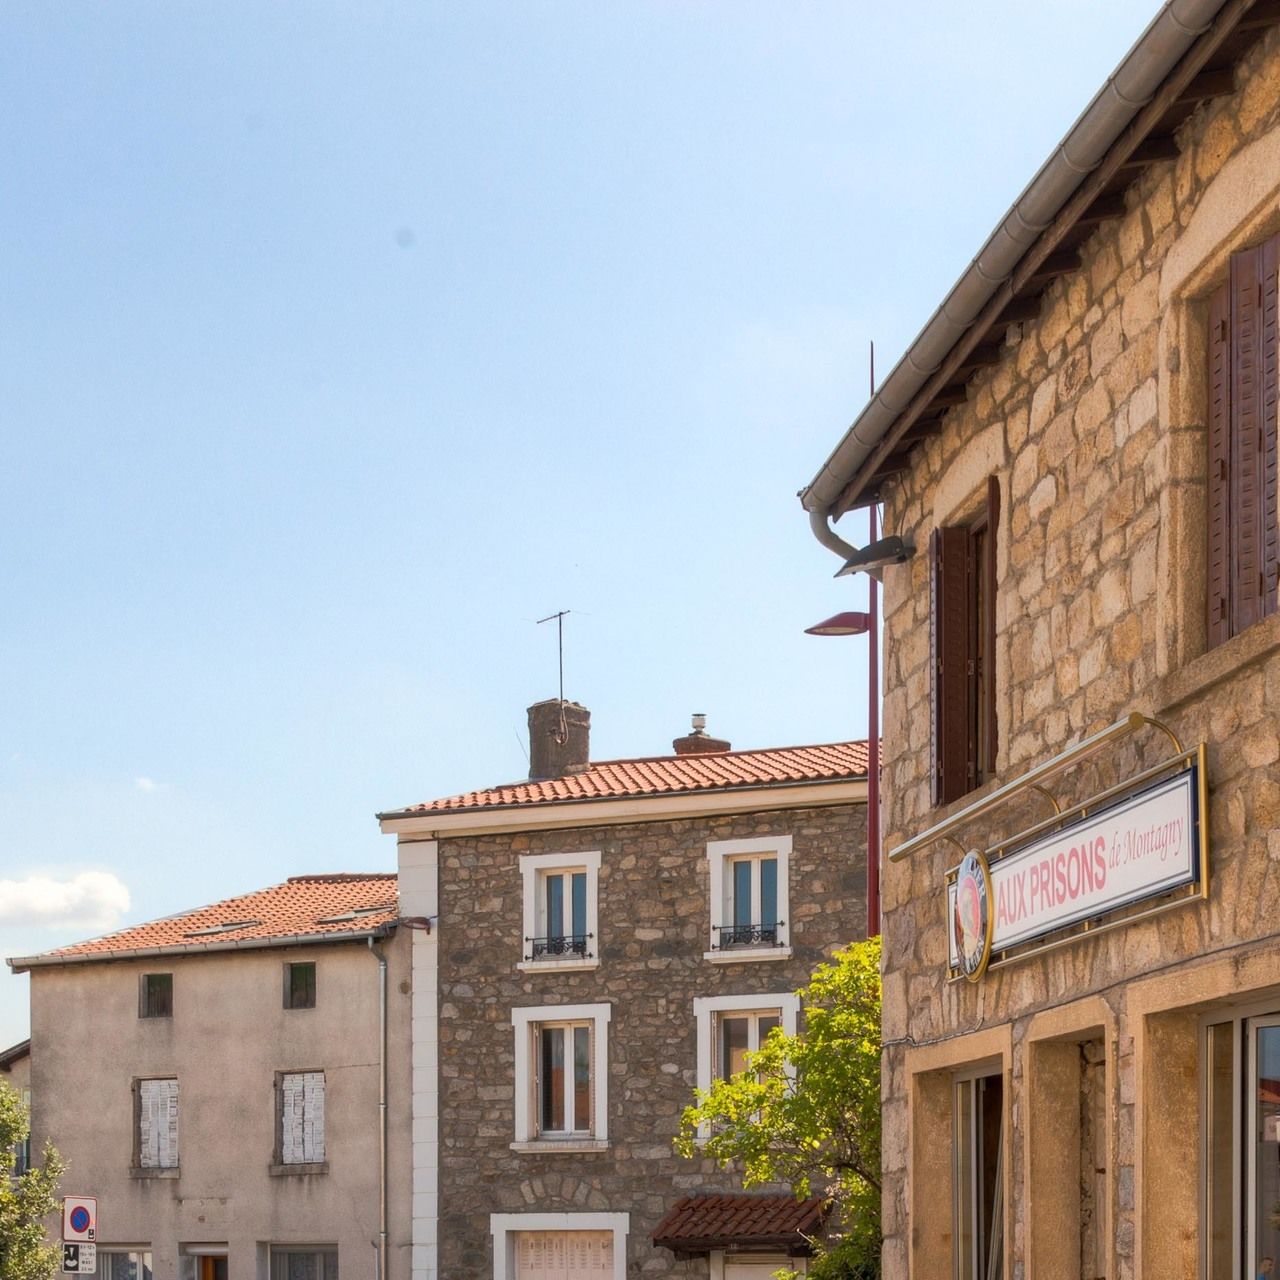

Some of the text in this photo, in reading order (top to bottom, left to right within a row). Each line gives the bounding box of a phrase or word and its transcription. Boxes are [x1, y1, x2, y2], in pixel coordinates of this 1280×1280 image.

[997, 869, 1028, 929] AUX
[1030, 835, 1107, 916] PRISONS
[1109, 831, 1121, 869] de
[1123, 817, 1184, 865] Montagny
